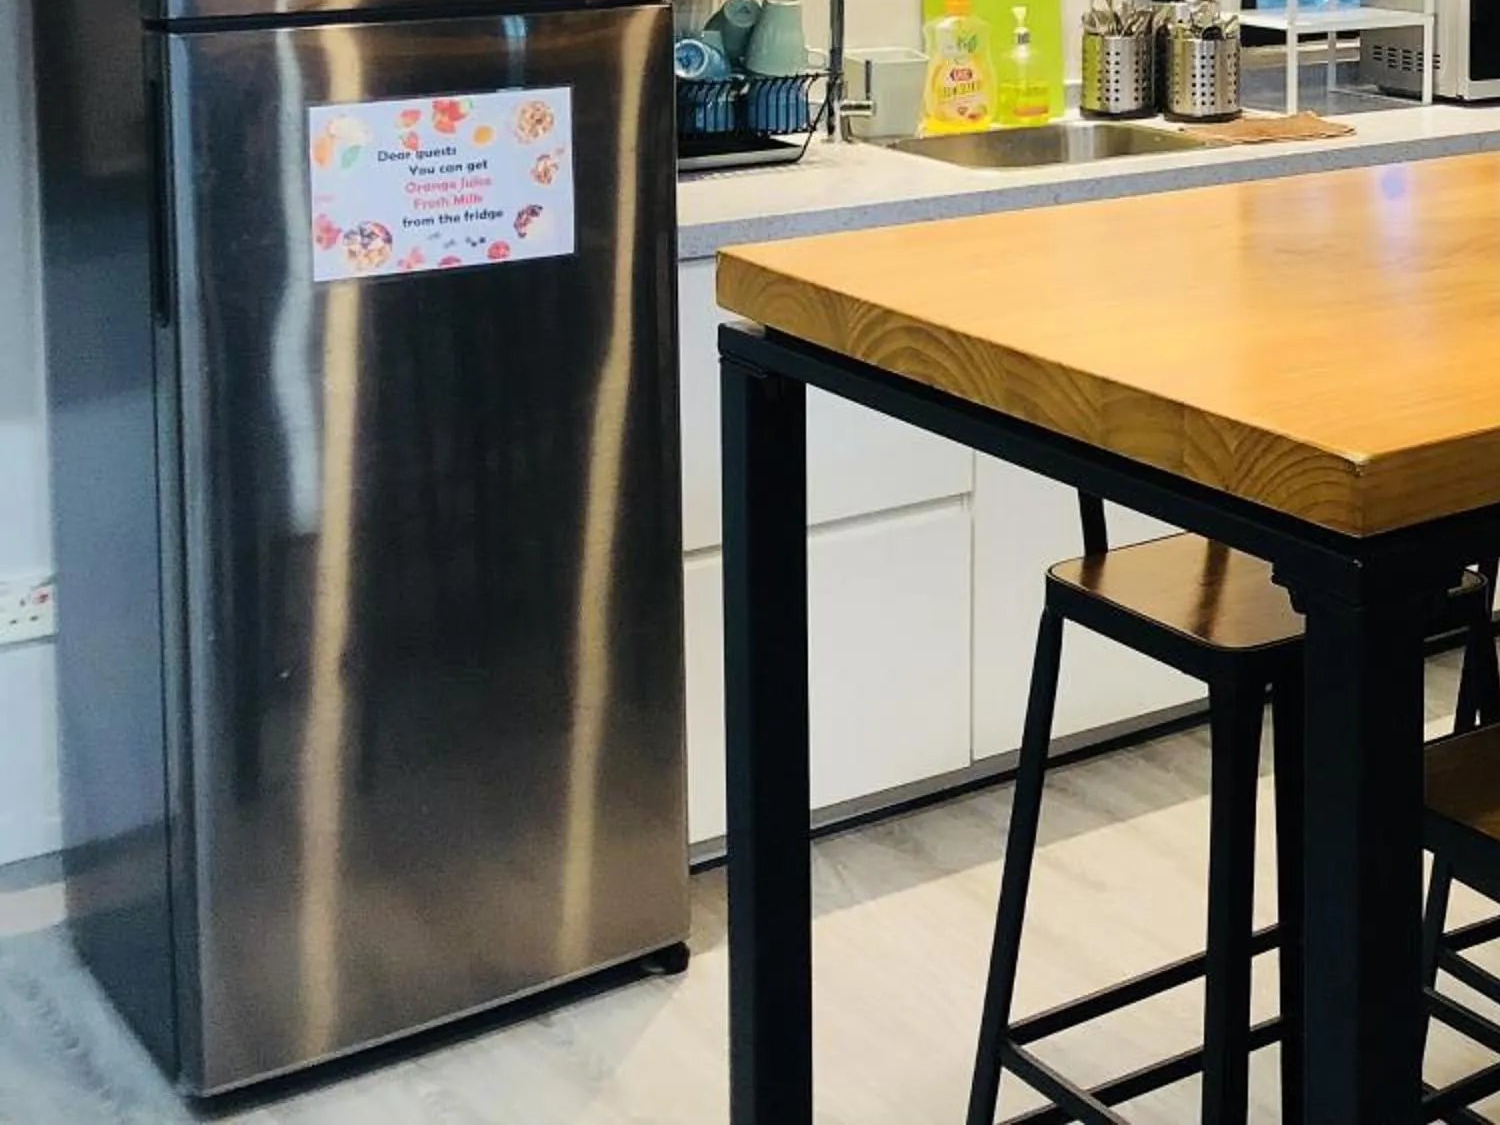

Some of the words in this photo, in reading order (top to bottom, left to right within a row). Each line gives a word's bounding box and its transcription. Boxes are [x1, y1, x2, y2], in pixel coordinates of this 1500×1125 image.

[377, 150, 412, 162] Dear
[408, 164, 435, 176] You
[439, 163, 463, 174] can
[466, 159, 488, 173] get
[402, 216, 435, 228] from
[438, 213, 461, 225] the
[464, 208, 504, 223] fridge
